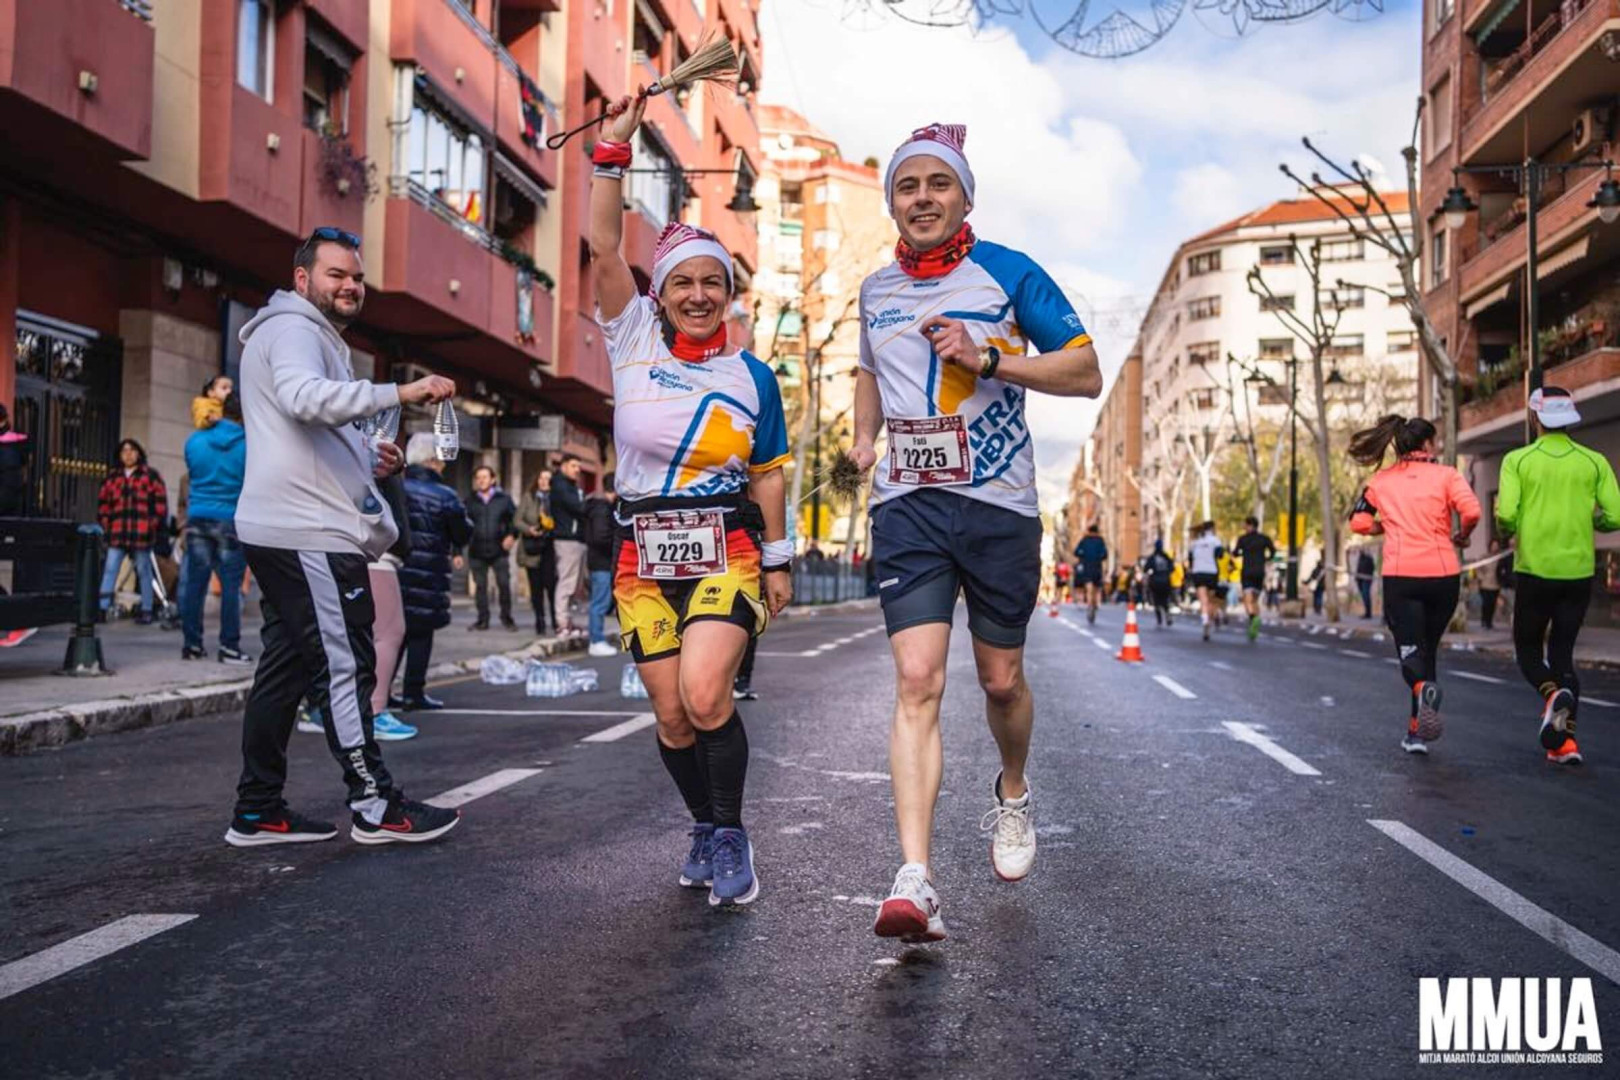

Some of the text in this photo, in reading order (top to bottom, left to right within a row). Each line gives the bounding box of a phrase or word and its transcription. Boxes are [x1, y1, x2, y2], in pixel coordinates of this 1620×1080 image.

[967, 386, 1023, 451] LTRA
[903, 447, 948, 469] 2225
[667, 532, 690, 541] Oscar
[657, 541, 703, 562] 2229
